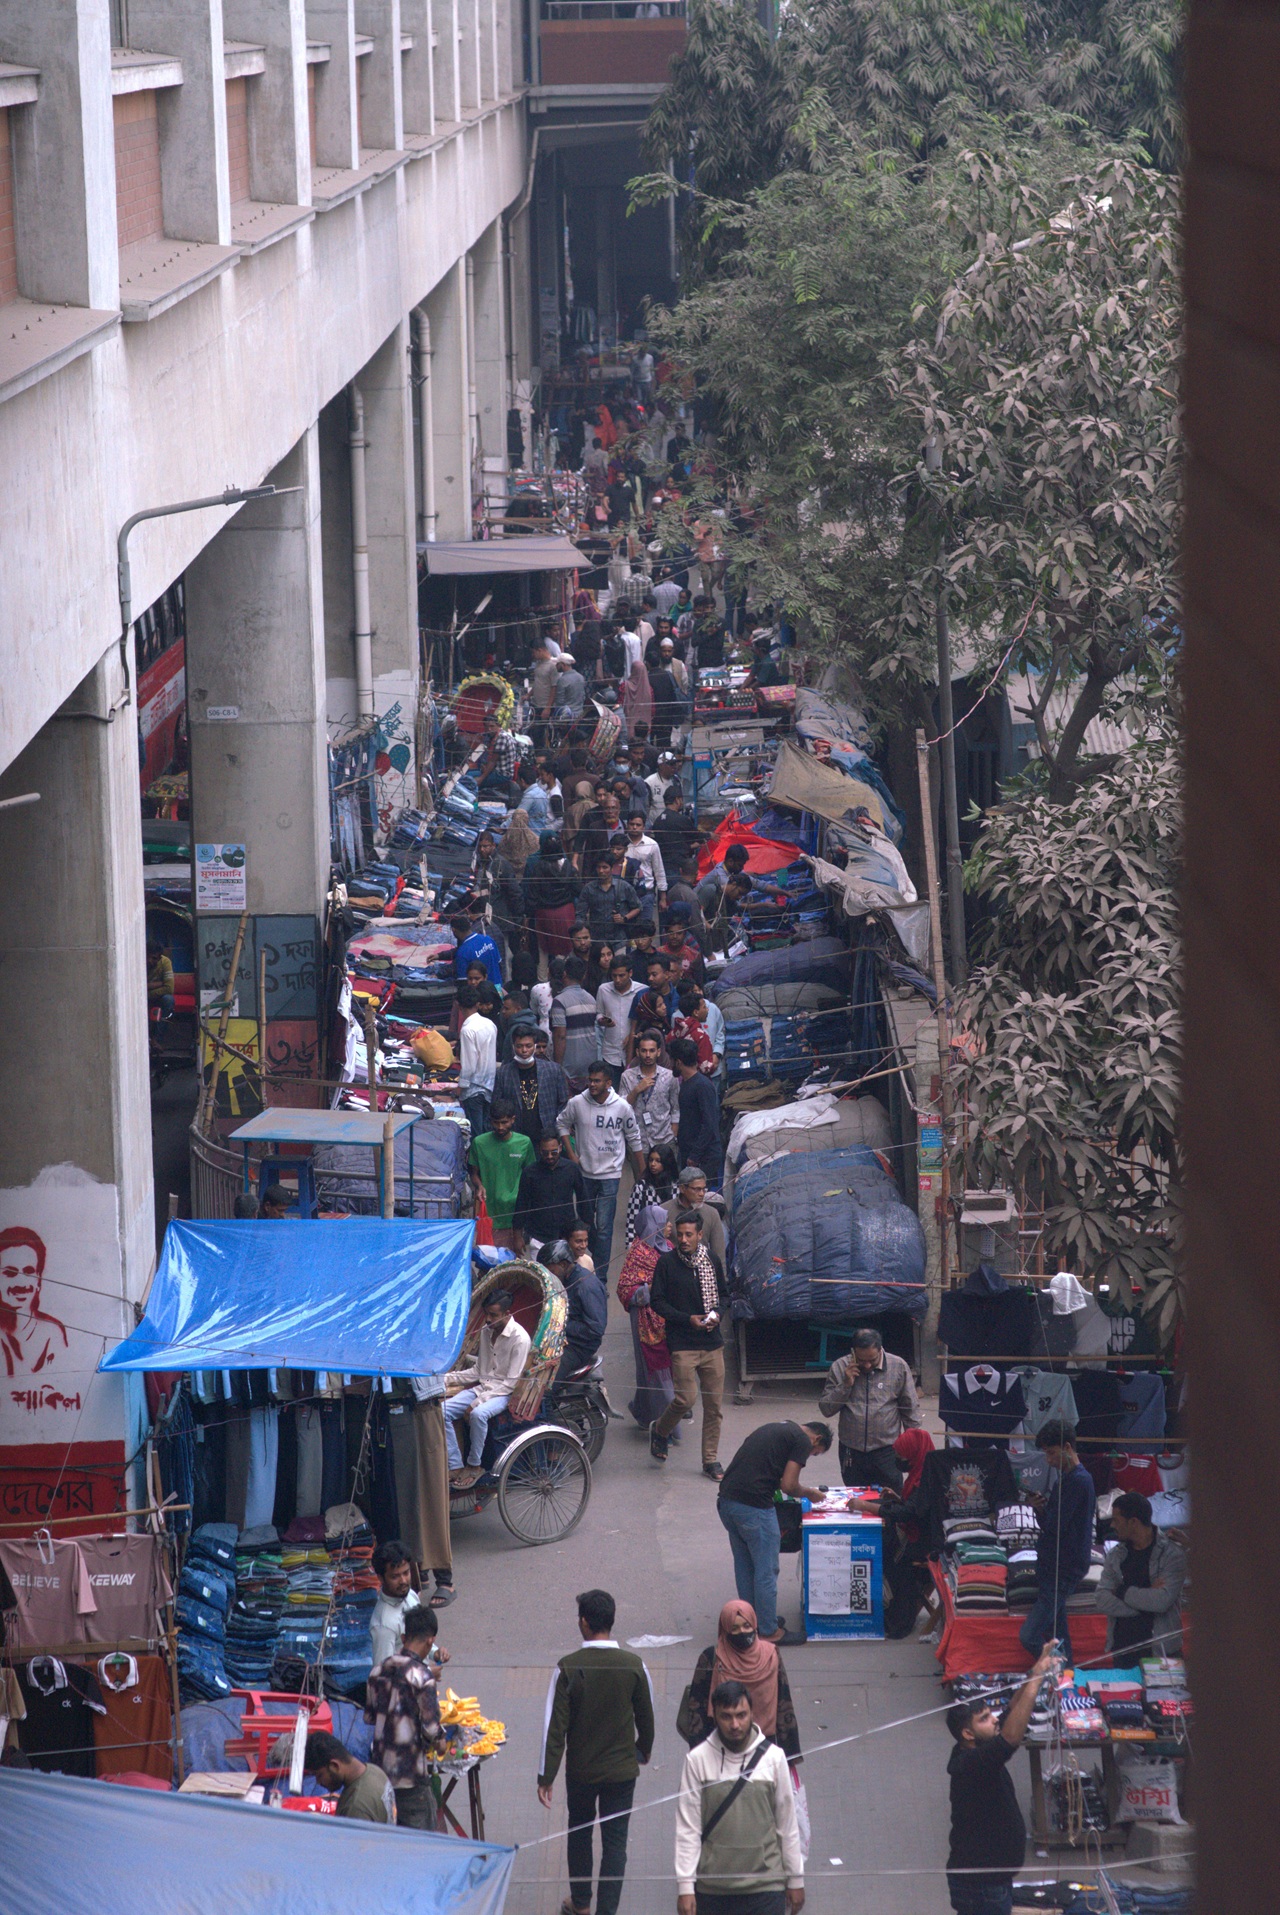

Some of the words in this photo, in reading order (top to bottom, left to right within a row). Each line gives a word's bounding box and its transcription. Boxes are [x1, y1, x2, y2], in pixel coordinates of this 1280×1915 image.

[205, 940, 246, 959] Patr
[10, 1384, 81, 1411] শাকিল
[11, 1573, 61, 1589] BELIEVE
[89, 1573, 136, 1586] KEEWAY
